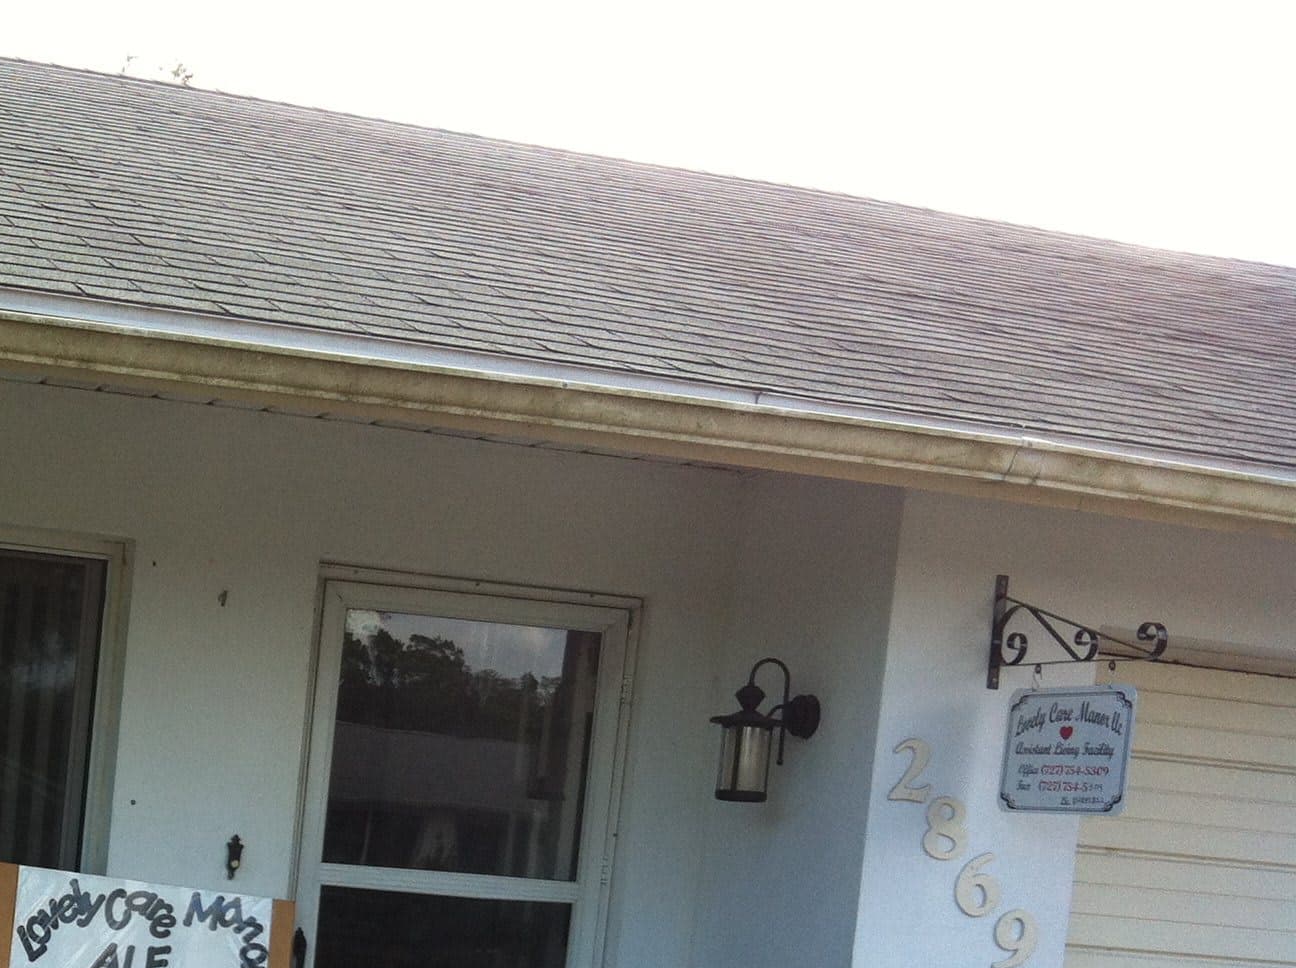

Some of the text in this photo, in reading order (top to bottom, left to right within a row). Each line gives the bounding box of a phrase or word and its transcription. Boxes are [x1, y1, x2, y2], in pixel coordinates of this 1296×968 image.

[1014, 707, 1046, 738] Lovely
[1049, 702, 1072, 724] Care
[1054, 741, 1080, 758] Living
[1082, 741, 1114, 759] Facility
[1018, 763, 1039, 777] Office
[1016, 779, 1032, 791] Fax
[17, 878, 106, 962] Lovely
[105, 888, 177, 938] Care
